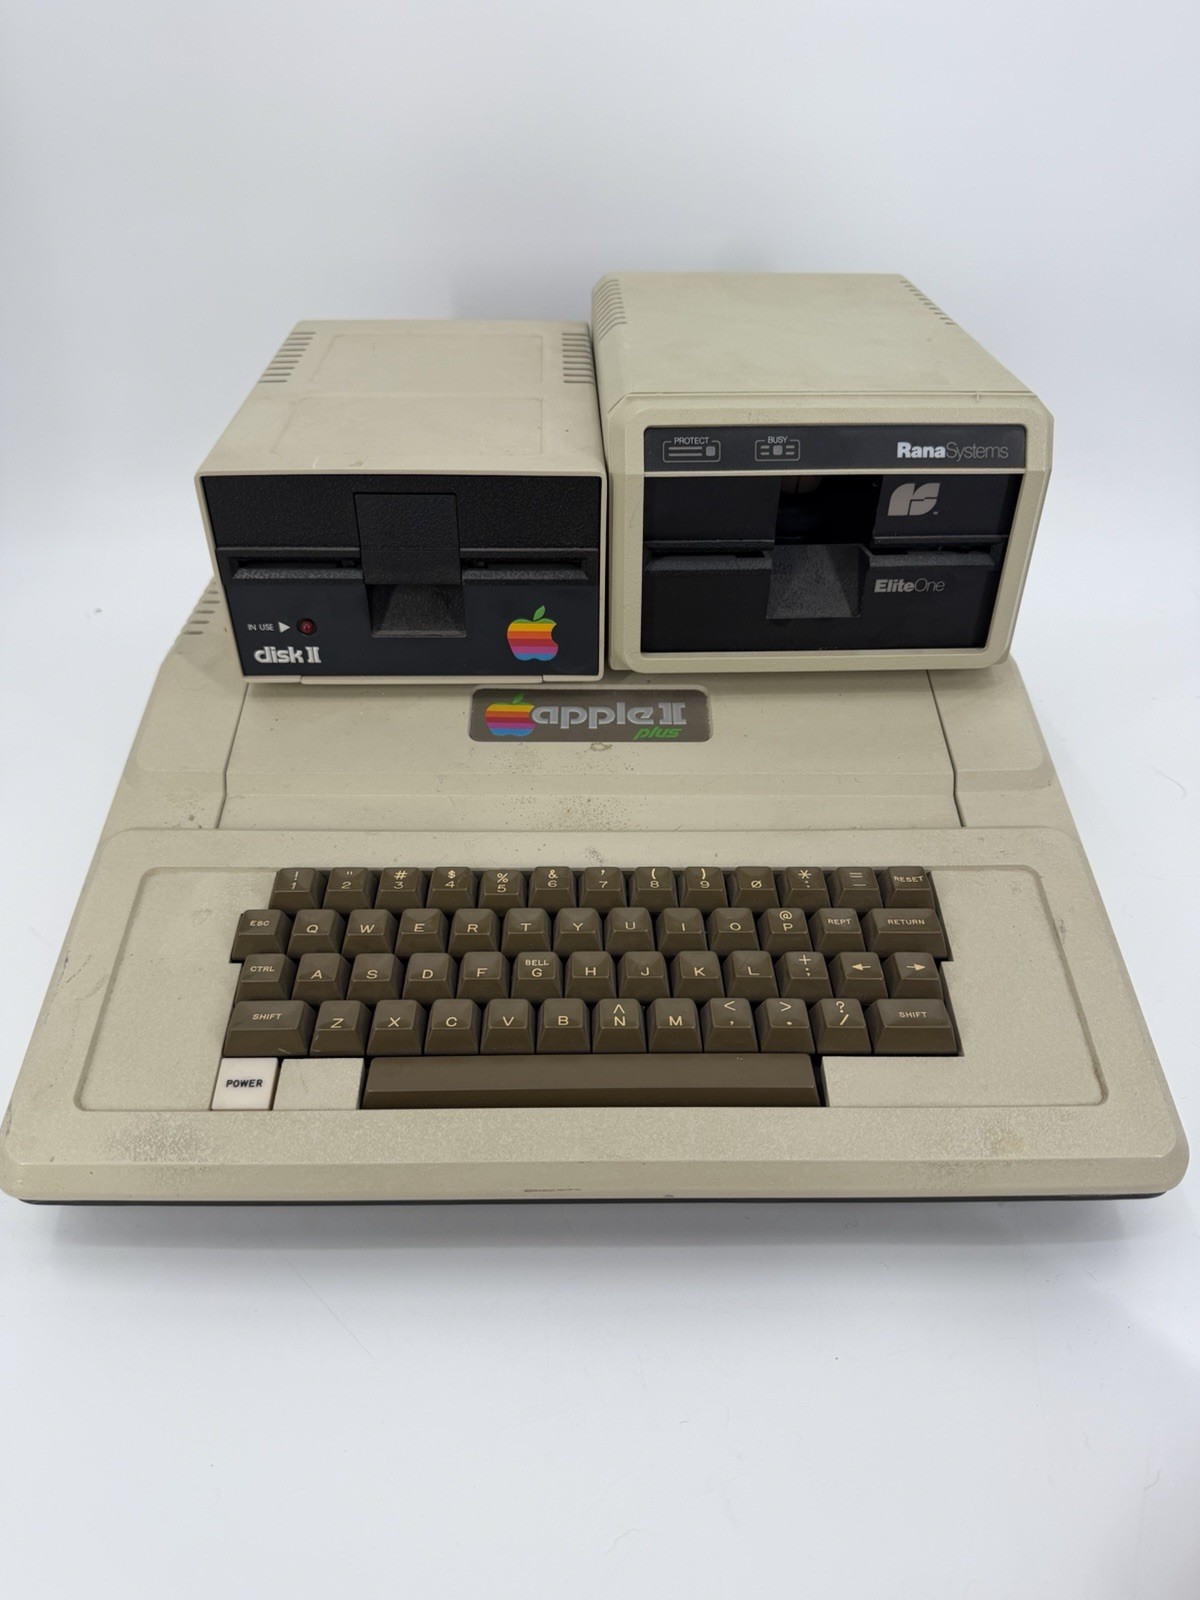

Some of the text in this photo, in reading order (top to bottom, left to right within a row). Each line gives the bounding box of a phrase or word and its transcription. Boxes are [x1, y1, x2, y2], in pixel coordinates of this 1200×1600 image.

[674, 436, 709, 445] PROTECT
[767, 436, 788, 444] BUSY
[248, 623, 274, 631] IN USE
[254, 646, 321, 664] disk II
[532, 702, 687, 728] apple II
[633, 726, 682, 739] plus
[548, 879, 558, 888] 6
[893, 875, 924, 883] RESET
[291, 881, 298, 889] 1
[341, 881, 352, 889] 2
[393, 880, 404, 889] 3
[445, 880, 456, 888] 4
[497, 884, 507, 893] 5
[598, 880, 609, 889] 7
[649, 880, 660, 888] 8
[700, 880, 710, 888] 9
[249, 919, 270, 927] ESC
[625, 921, 637, 930] U
[729, 922, 742, 931] O
[827, 918, 851, 926] REPT
[887, 918, 925, 926] RETURN
[306, 924, 319, 934] Q
[360, 924, 375, 933] W
[413, 923, 425, 933] E
[467, 923, 478, 933] R
[520, 922, 532, 932] T
[572, 922, 584, 932] Y
[783, 923, 793, 931] P
[524, 958, 550, 967] BELL
[250, 965, 275, 973] CTRL
[476, 967, 488, 978] F
[531, 968, 543, 977] G
[584, 967, 597, 977] H
[639, 966, 650, 976] J
[694, 967, 706, 976] K
[748, 966, 760, 976] L
[310, 969, 323, 979] A
[366, 969, 378, 979] S
[422, 969, 434, 979] D
[252, 1012, 282, 1020] SHIFT
[558, 1016, 569, 1025] B
[330, 1018, 344, 1028] Z
[388, 1017, 401, 1028] X
[445, 1017, 458, 1027] C
[502, 1016, 514, 1027] V
[613, 1016, 626, 1027] N
[669, 1016, 683, 1026] M
[225, 1079, 263, 1088] POWER
